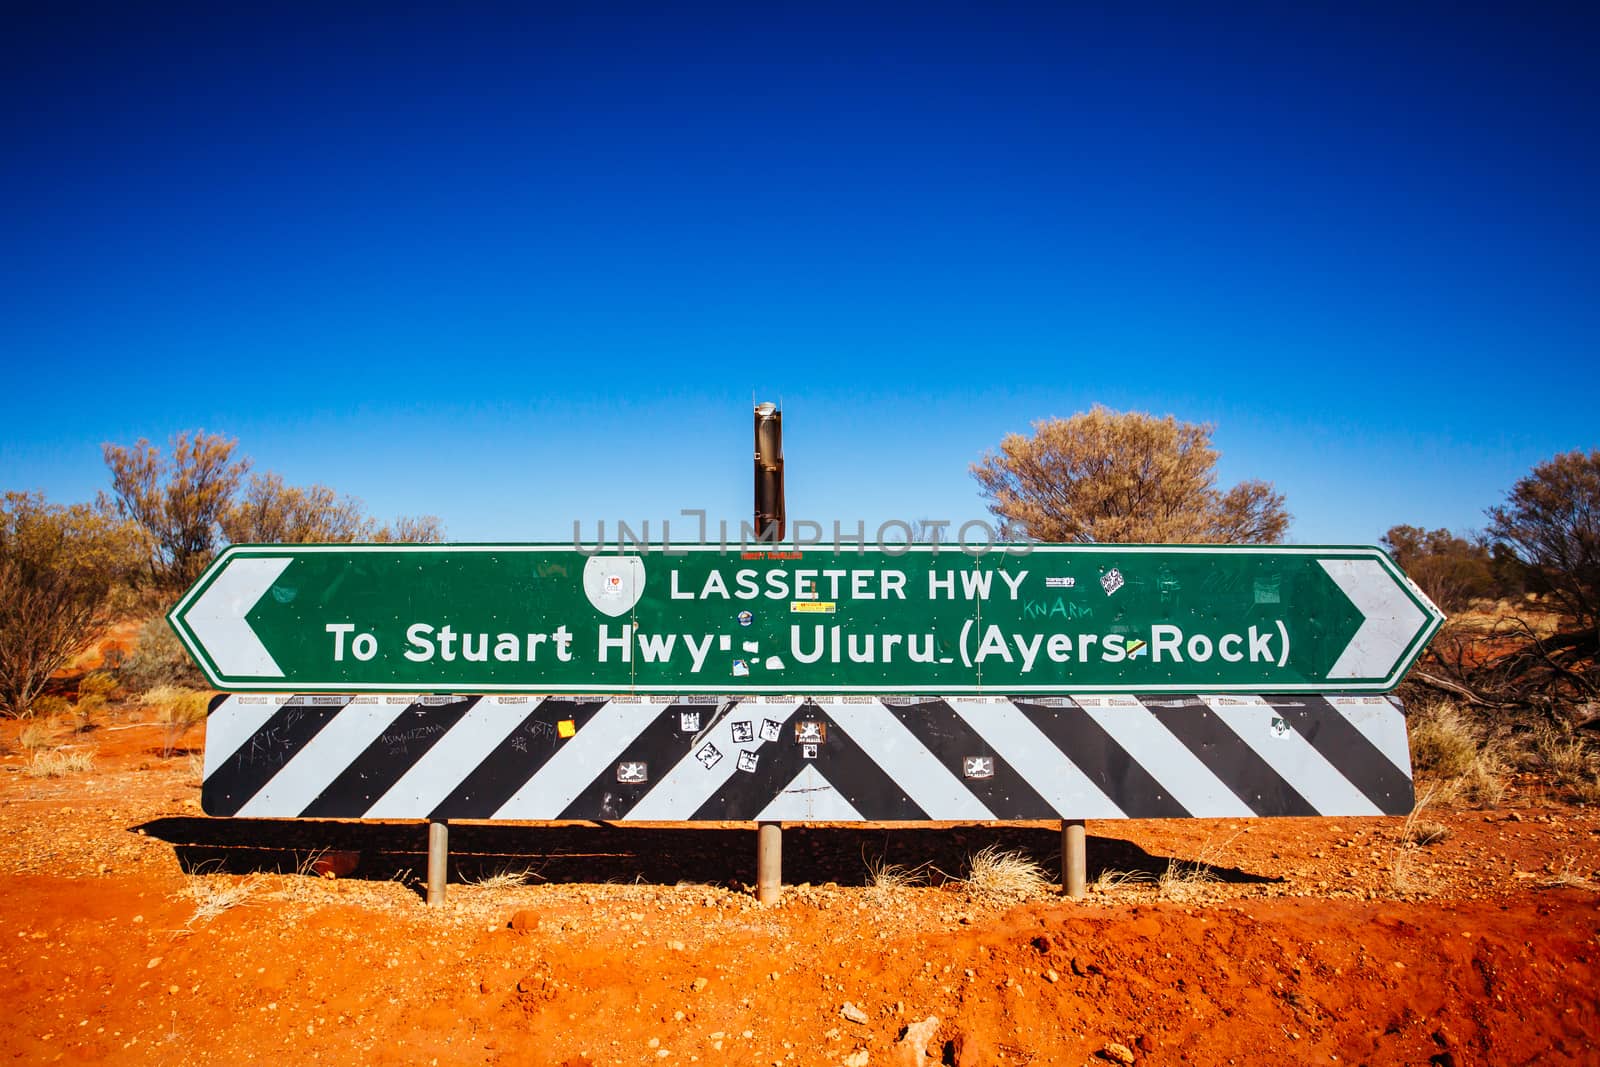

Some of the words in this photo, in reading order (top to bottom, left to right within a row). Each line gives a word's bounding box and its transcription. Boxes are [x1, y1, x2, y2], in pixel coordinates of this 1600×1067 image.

[671, 569, 907, 601] LASSETER
[928, 570, 1029, 600] HWY
[325, 624, 378, 662] To
[404, 623, 573, 663] Stuart
[598, 624, 713, 674] Hwy
[791, 624, 938, 664] Uluru
[959, 619, 1127, 674] (Ayers
[1151, 620, 1291, 668] Rock)
